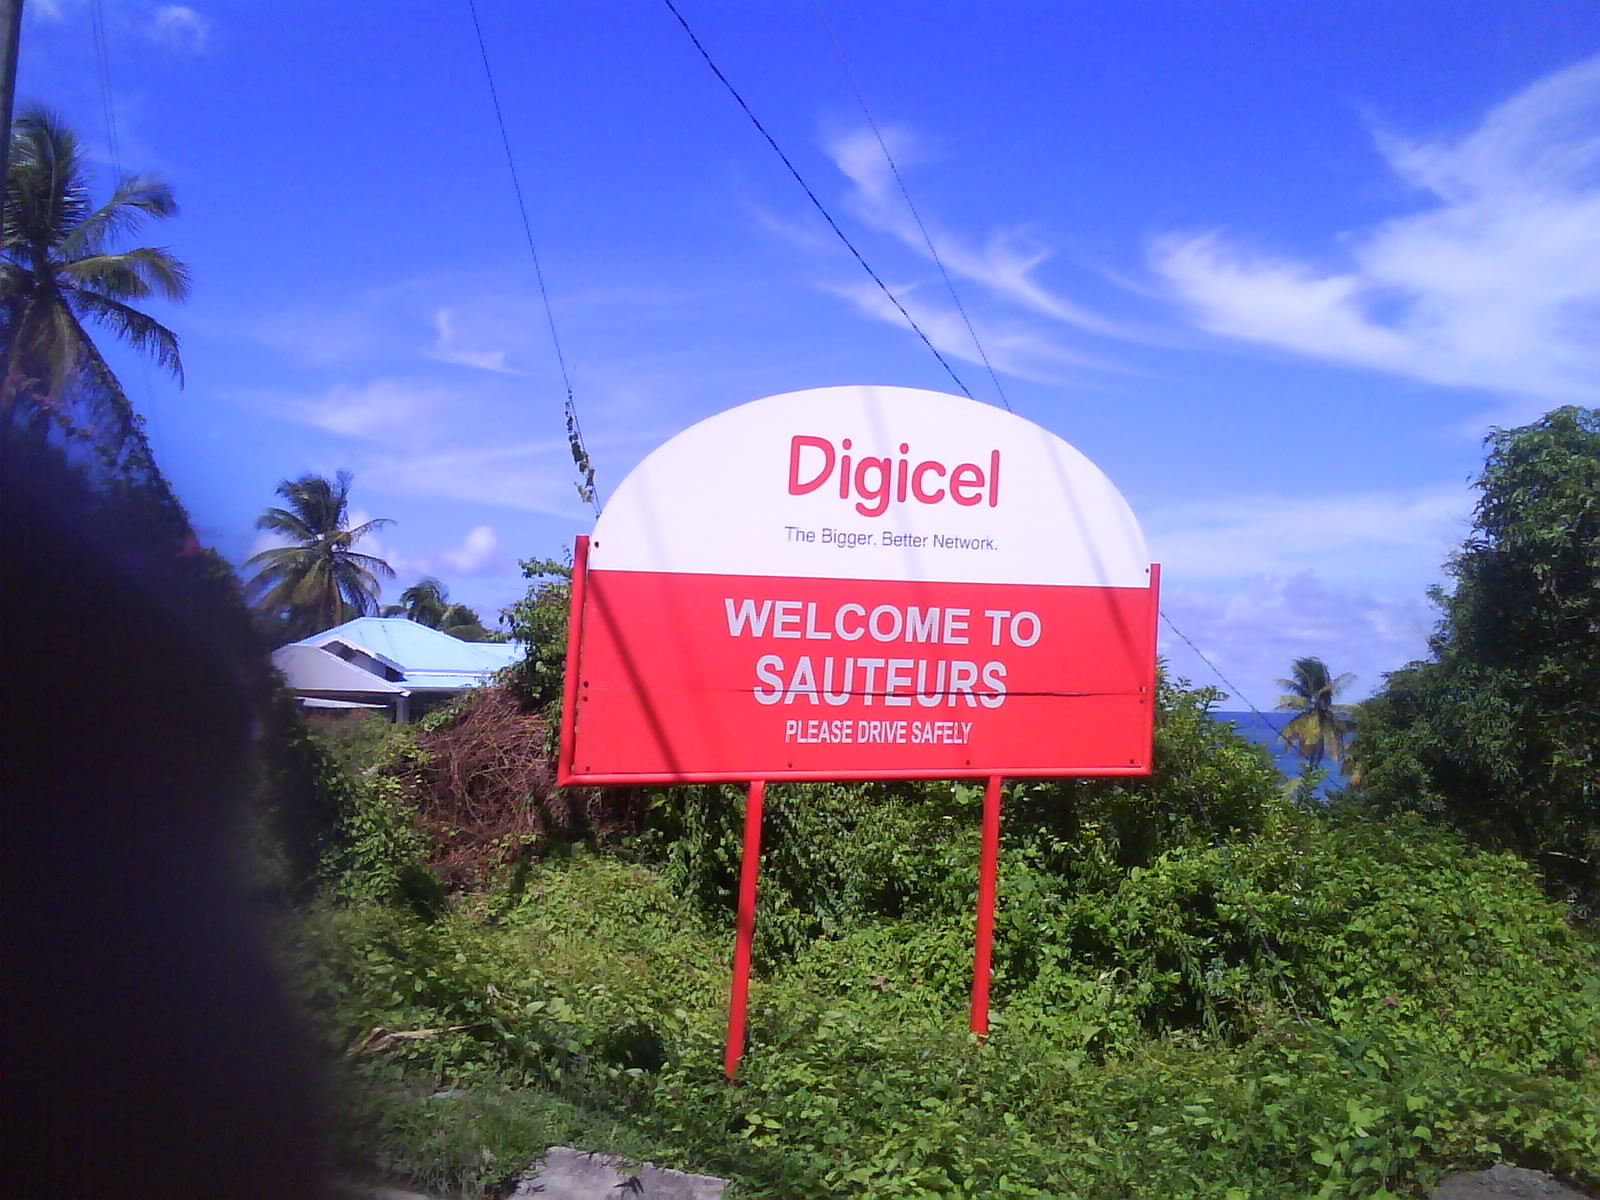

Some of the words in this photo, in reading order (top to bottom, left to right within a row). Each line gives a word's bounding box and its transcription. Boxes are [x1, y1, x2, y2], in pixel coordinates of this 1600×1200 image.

[788, 435, 1000, 517] Digicel
[785, 526, 815, 543] The
[882, 531, 928, 548] Better
[933, 534, 998, 551] Network.
[724, 598, 970, 644] WELCOME
[984, 609, 1041, 647] TO
[753, 655, 1008, 708] SAUTEURS
[785, 720, 852, 743] PLEASE
[857, 720, 907, 744] DRIVE
[911, 721, 973, 745] SAFELY
